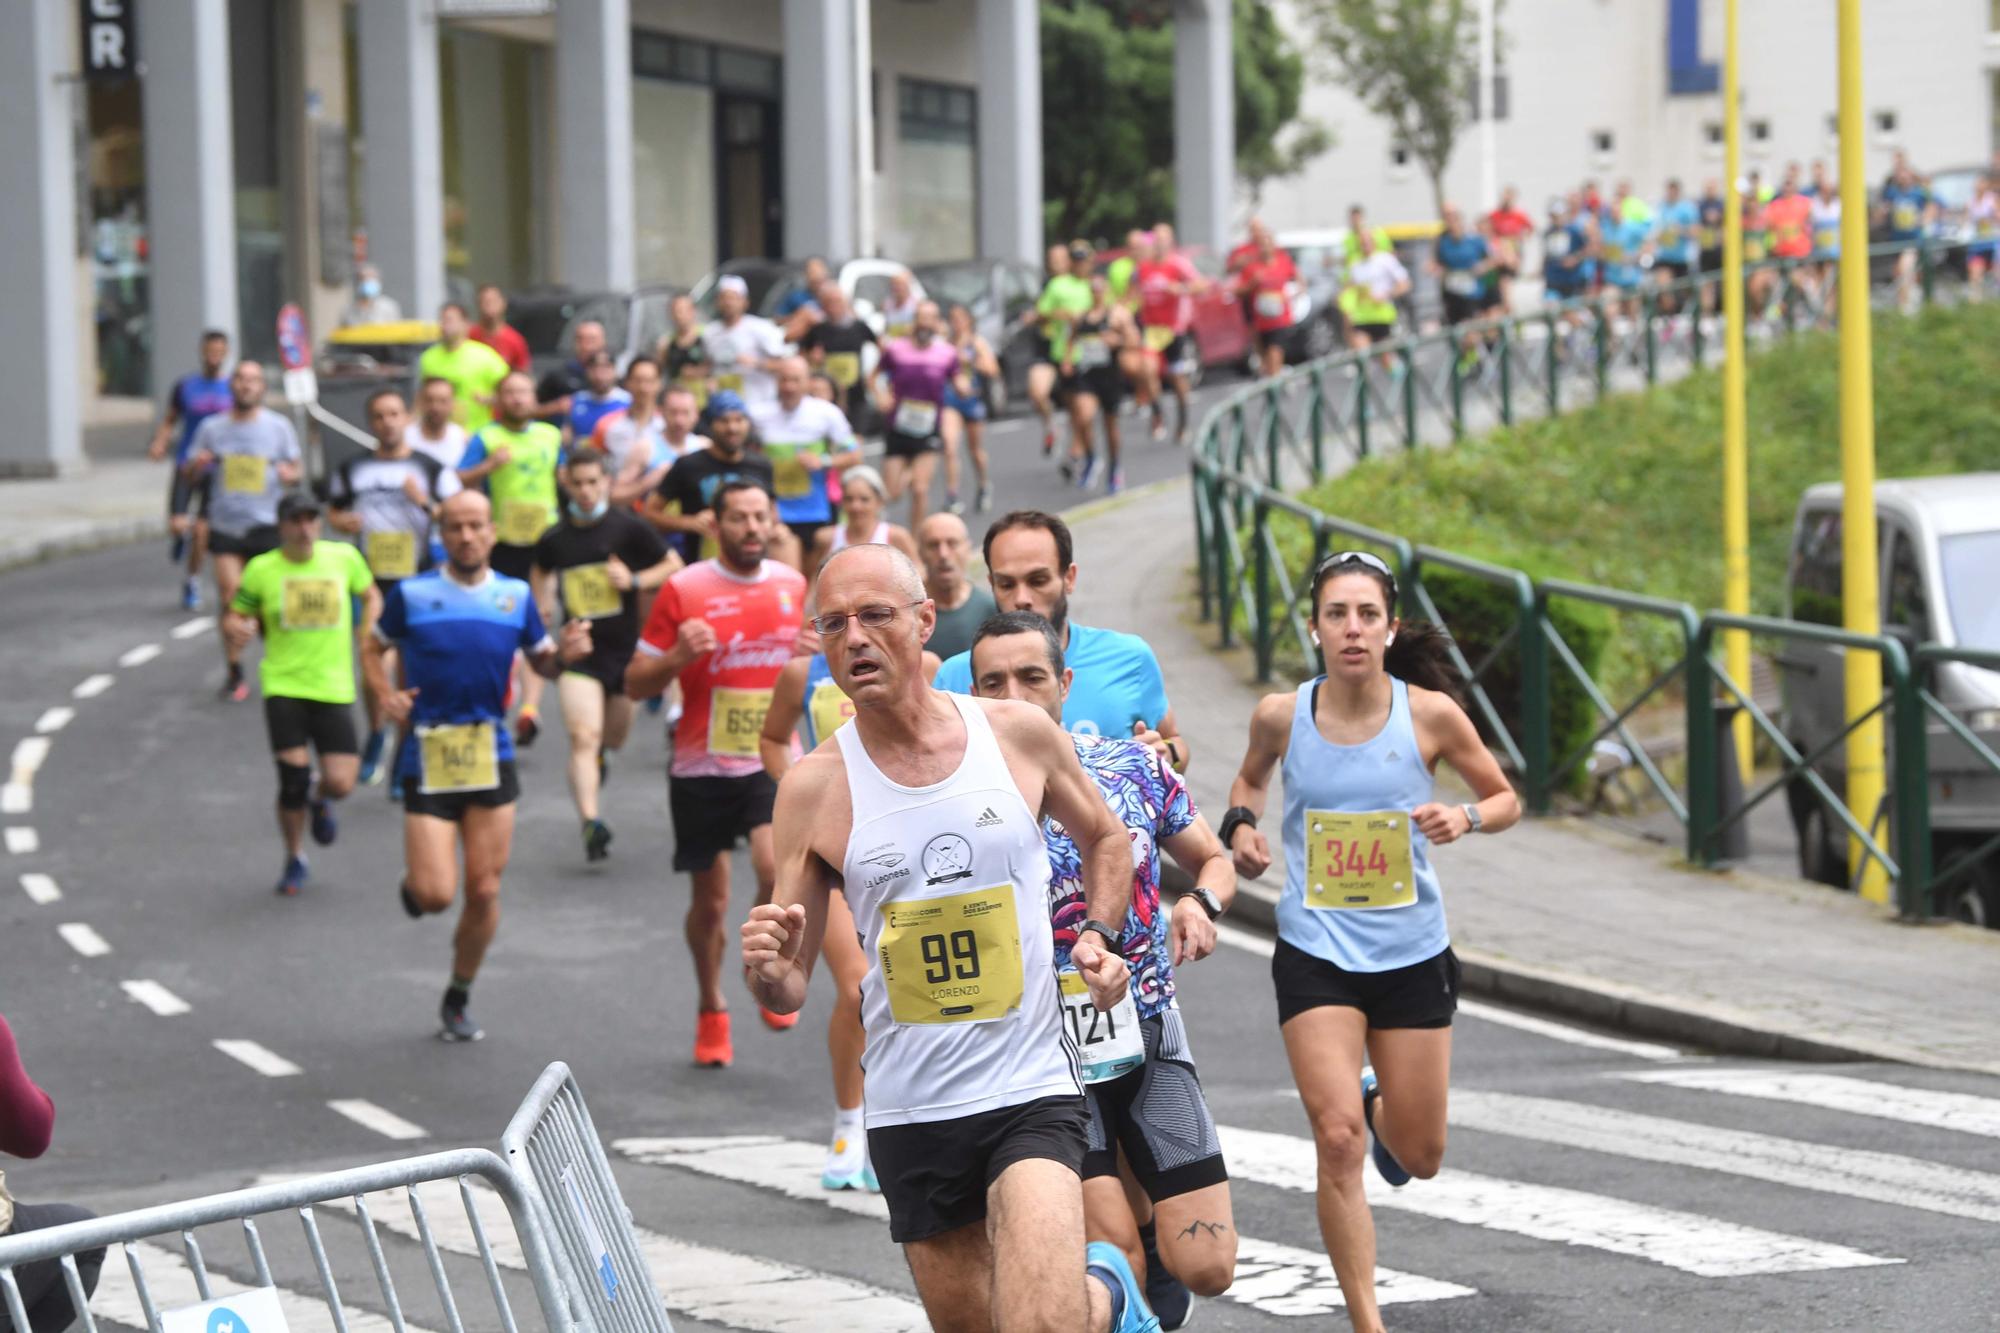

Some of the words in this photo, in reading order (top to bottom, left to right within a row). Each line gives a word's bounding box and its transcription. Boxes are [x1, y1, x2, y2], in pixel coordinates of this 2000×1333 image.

[975, 818, 1004, 828] adidas
[1326, 839, 1389, 878] 344
[873, 867, 911, 886] Leonesa
[880, 945, 894, 974] TANDA
[921, 930, 981, 984] 99
[932, 985, 980, 999] LORENZO
